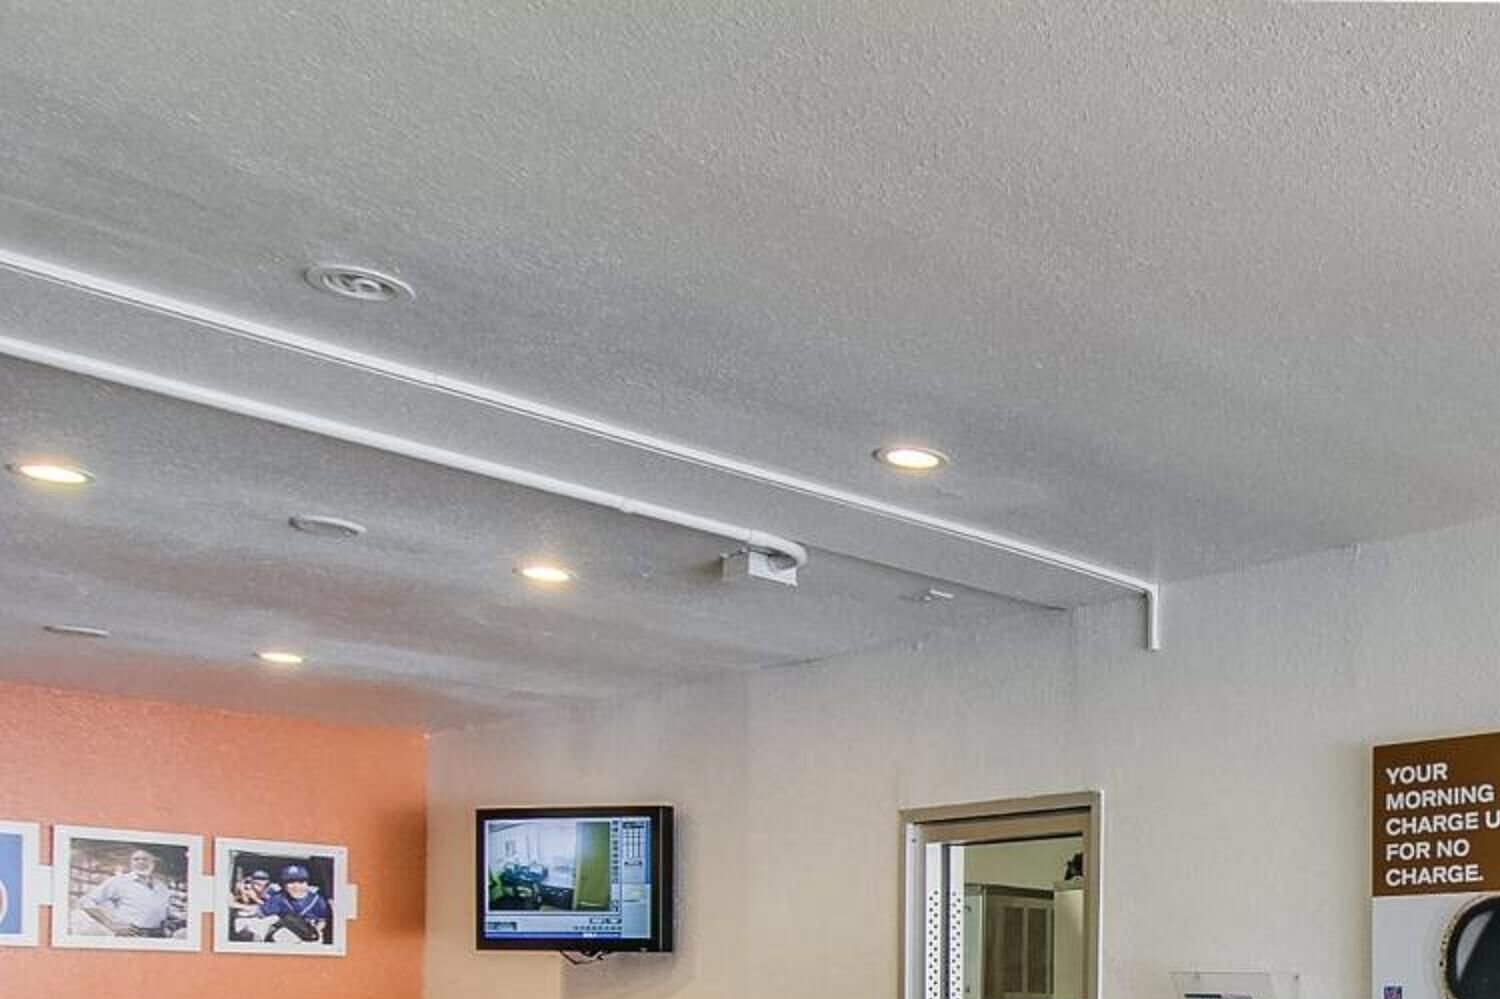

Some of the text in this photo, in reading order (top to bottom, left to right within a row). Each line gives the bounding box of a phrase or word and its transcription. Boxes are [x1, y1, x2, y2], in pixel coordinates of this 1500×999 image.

[1385, 762, 1449, 785] YOUR
[1385, 783, 1496, 812] MORNING
[1385, 811, 1480, 837] CHARGE
[1385, 838, 1471, 861] FOR NO
[1385, 863, 1485, 887] CHARGE.
